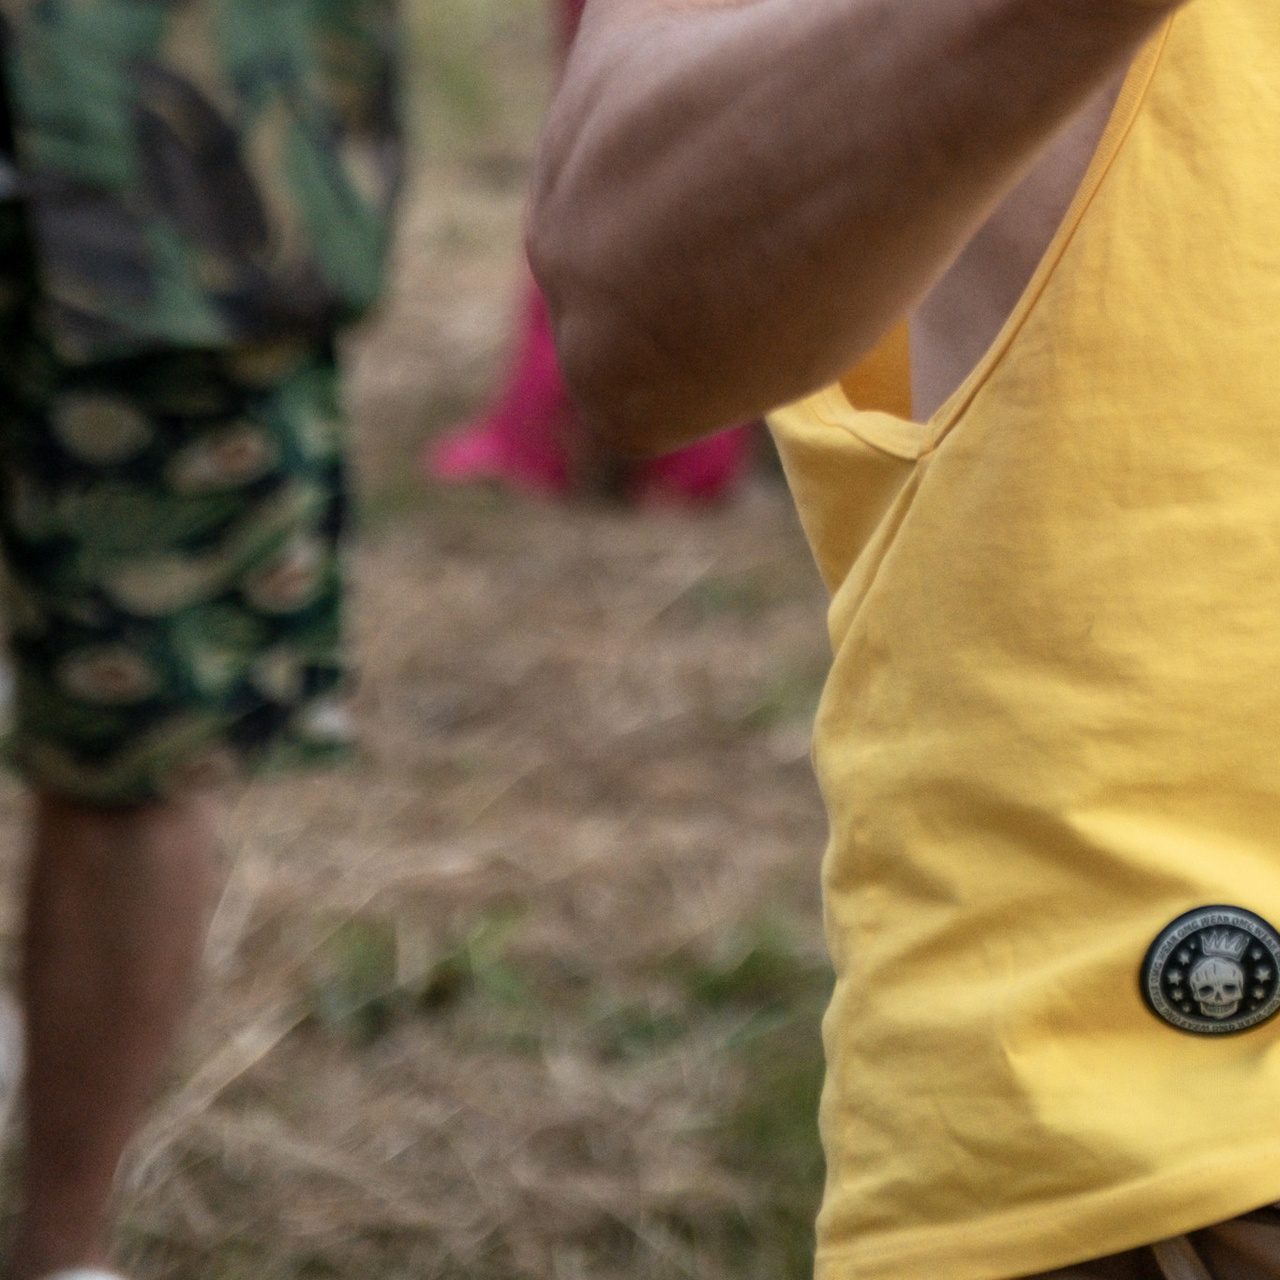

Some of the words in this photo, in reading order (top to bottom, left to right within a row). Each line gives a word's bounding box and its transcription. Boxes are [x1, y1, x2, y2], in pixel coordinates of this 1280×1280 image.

[1177, 920, 1198, 938] OMG
[1200, 915, 1229, 927] WEAR
[1232, 918, 1254, 931] OMG
